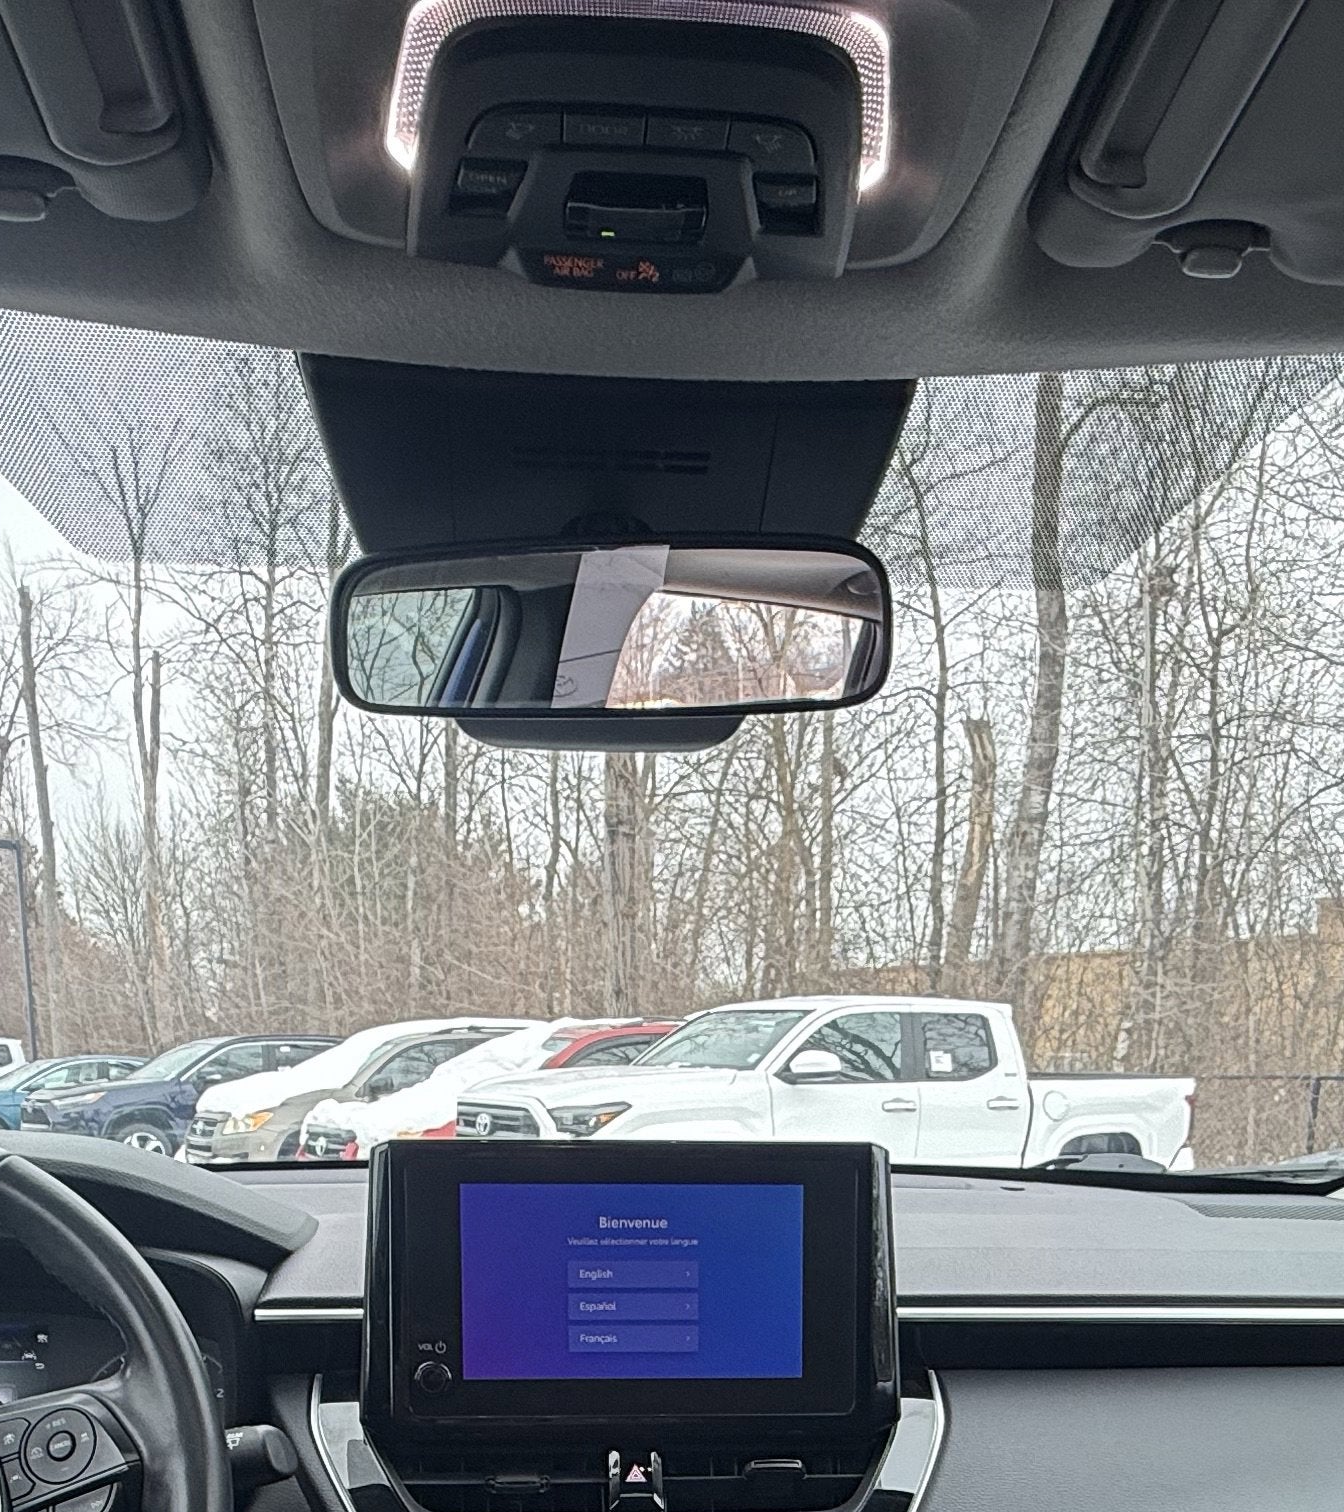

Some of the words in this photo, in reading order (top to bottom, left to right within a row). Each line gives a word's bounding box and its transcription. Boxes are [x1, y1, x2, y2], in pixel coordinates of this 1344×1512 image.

[544, 255, 604, 268] PASSENGER
[616, 270, 637, 280] OFF
[599, 1216, 668, 1229] Bienvenue
[567, 1237, 598, 1246] Veuillez
[649, 1238, 668, 1246] votre
[670, 1237, 698, 1248] langue
[579, 1269, 613, 1280] English
[579, 1301, 616, 1312] Español
[579, 1334, 617, 1344] Français
[417, 1342, 433, 1351] VOL
